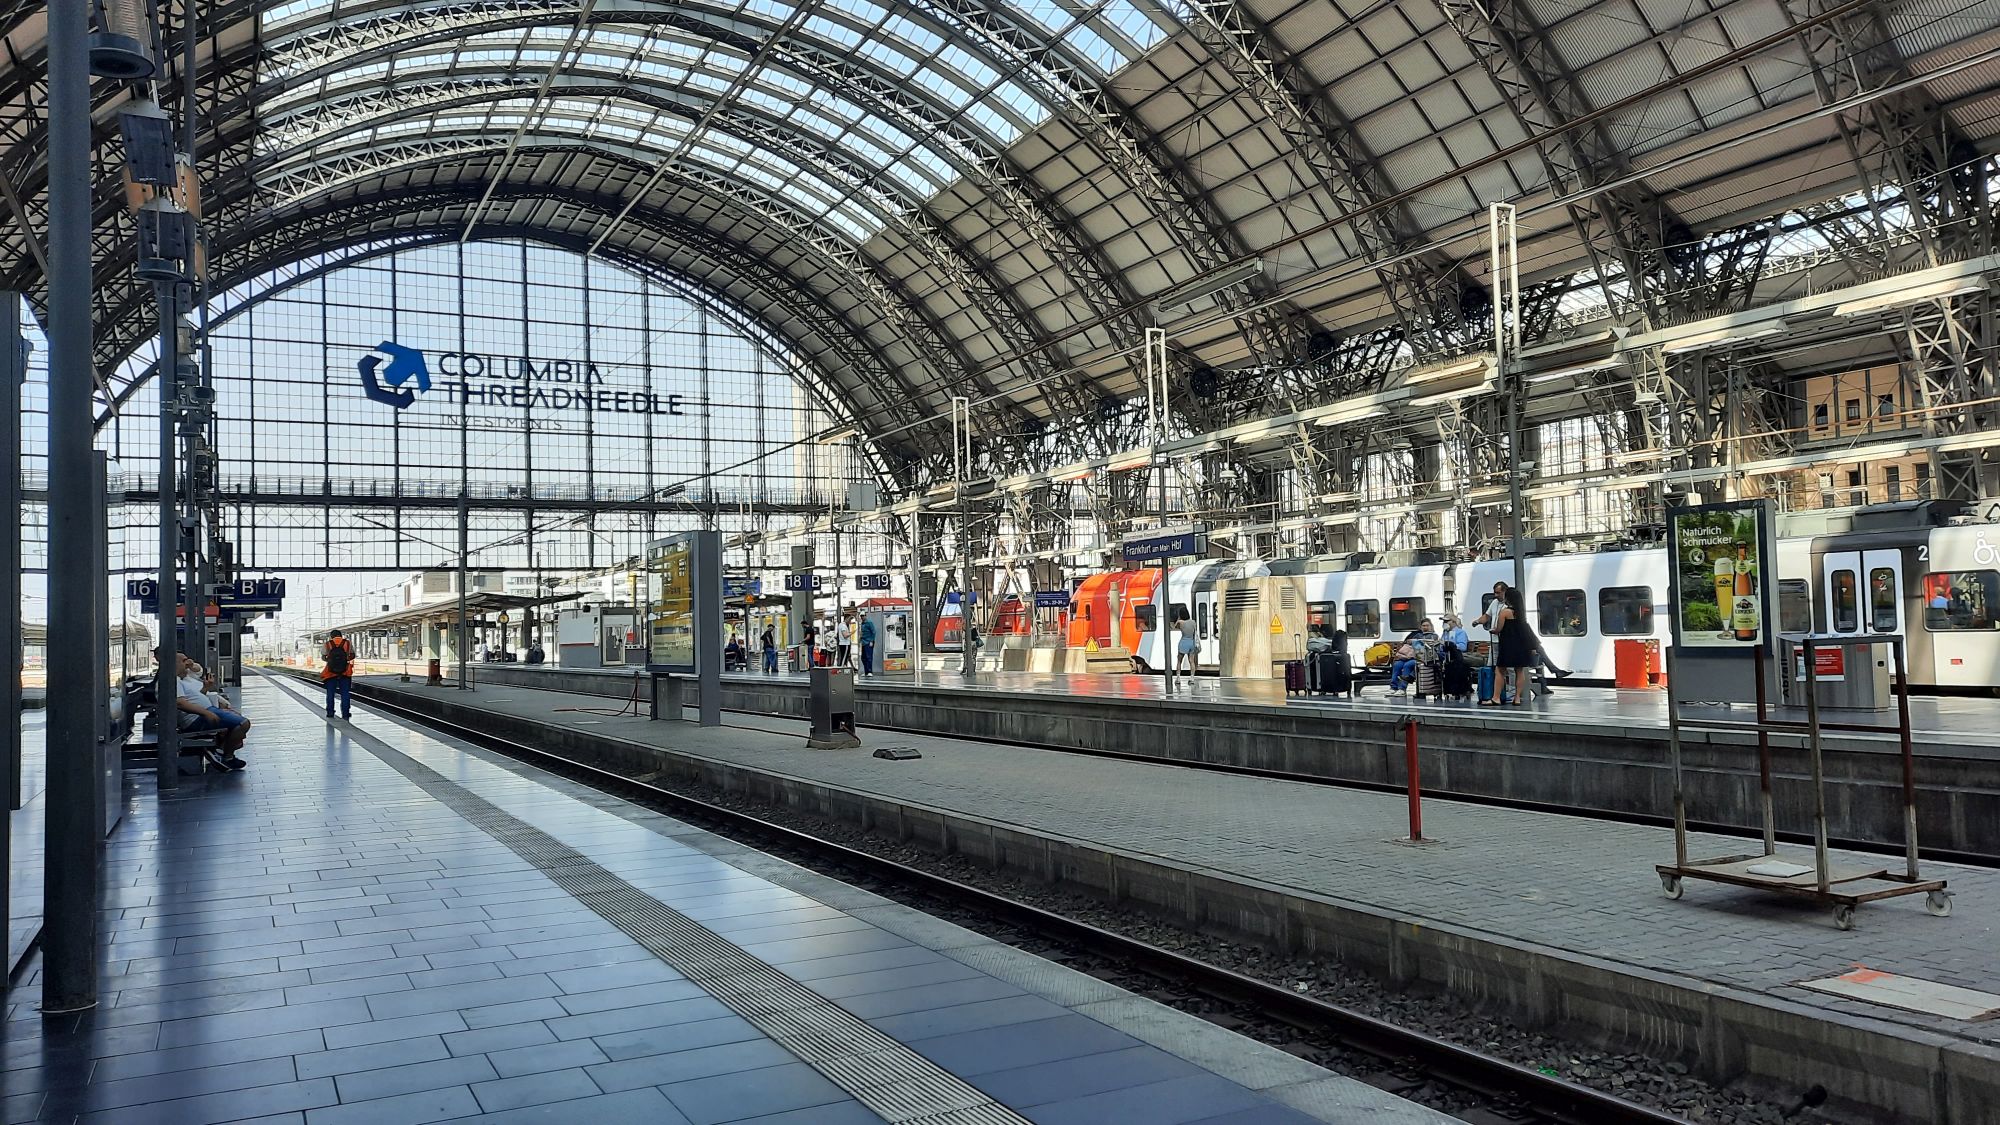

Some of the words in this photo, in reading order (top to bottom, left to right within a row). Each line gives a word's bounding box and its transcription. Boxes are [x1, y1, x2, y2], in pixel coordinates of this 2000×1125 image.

[438, 352, 604, 385] COLUMBIA
[440, 381, 684, 416] THREADNEEDLE
[440, 414, 563, 430] INVESTMENTS
[1682, 526, 1722, 538] Natürlich
[1126, 543, 1152, 556] Frankfurt
[1159, 544, 1171, 552] Main
[1171, 540, 1183, 551] Hbf
[1682, 536, 1733, 547] Schmucker
[1918, 545, 1929, 561] 2
[129, 580, 151, 596] 16
[241, 580, 255, 595] B
[264, 579, 283, 595] 17
[787, 575, 802, 588] 18
[811, 575, 821, 588] B
[861, 574, 870, 587] B
[876, 574, 889, 587] 19
[1780, 658, 1790, 698] Abfall
